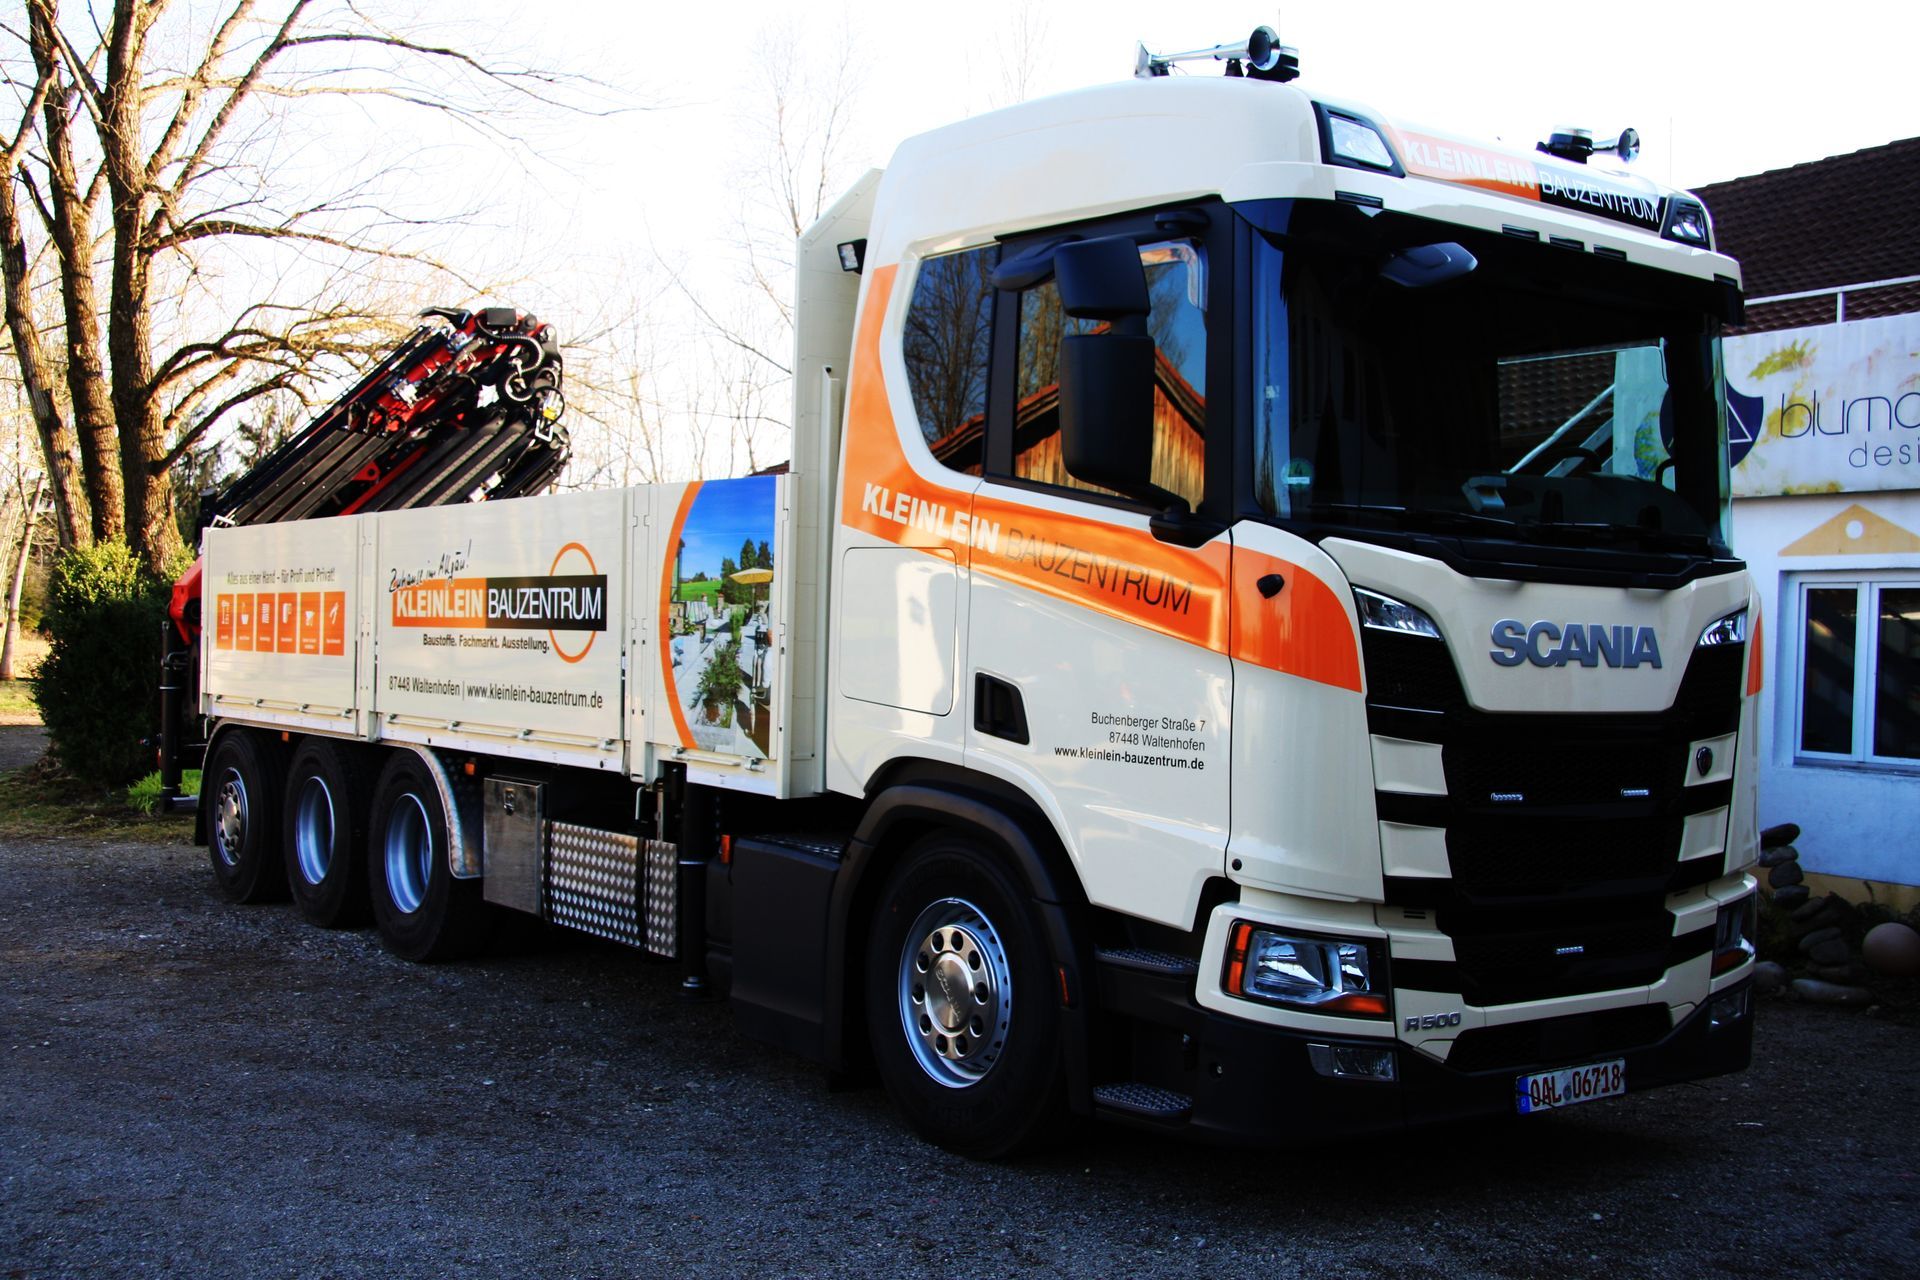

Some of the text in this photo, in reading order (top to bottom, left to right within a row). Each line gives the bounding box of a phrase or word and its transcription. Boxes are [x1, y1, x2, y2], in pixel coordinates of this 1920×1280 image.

[1402, 139, 1660, 224] KLEINLEIN BAUZENTRUM
[862, 482, 1193, 615] KLEINLEIN BAUZENTRUM
[396, 587, 601, 620] KLEINLEIN BAUZENTRUM
[423, 634, 550, 653] Baustoffe. Fachmarkt. Ausstellung.
[1490, 618, 1662, 668] SCANIA
[412, 678, 460, 696] Waltenhofen
[467, 684, 603, 709] www.kleinlein-bauzentrum.de
[1091, 712, 1206, 732] Buchenberger Straße 7
[1109, 732, 1205, 751] 87448 Waltenhofen
[1054, 746, 1205, 770] www.kleinlein-bauzentrum.de
[1572, 1063, 1620, 1098] 06718
